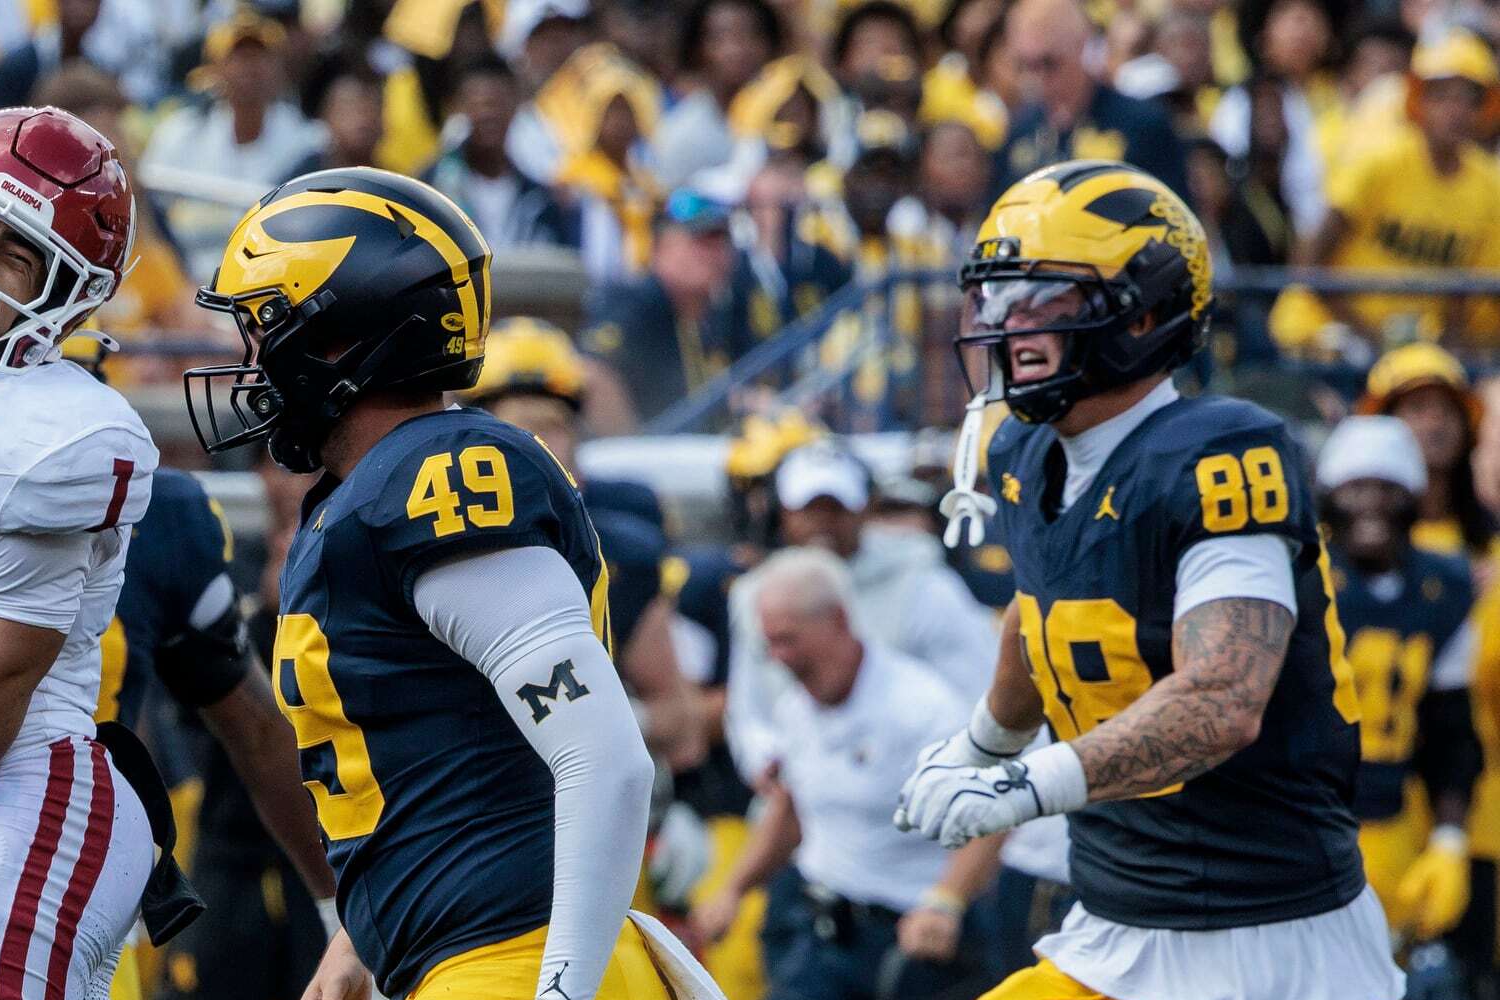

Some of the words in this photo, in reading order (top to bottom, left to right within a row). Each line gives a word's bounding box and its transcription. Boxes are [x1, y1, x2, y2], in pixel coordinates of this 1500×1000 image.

[1, 180, 42, 211] OKLAHOMA
[447, 336, 464, 354] 49
[84, 457, 135, 533] 1
[406, 445, 515, 538] 49
[1195, 446, 1289, 533] 88
[516, 659, 590, 725] M
